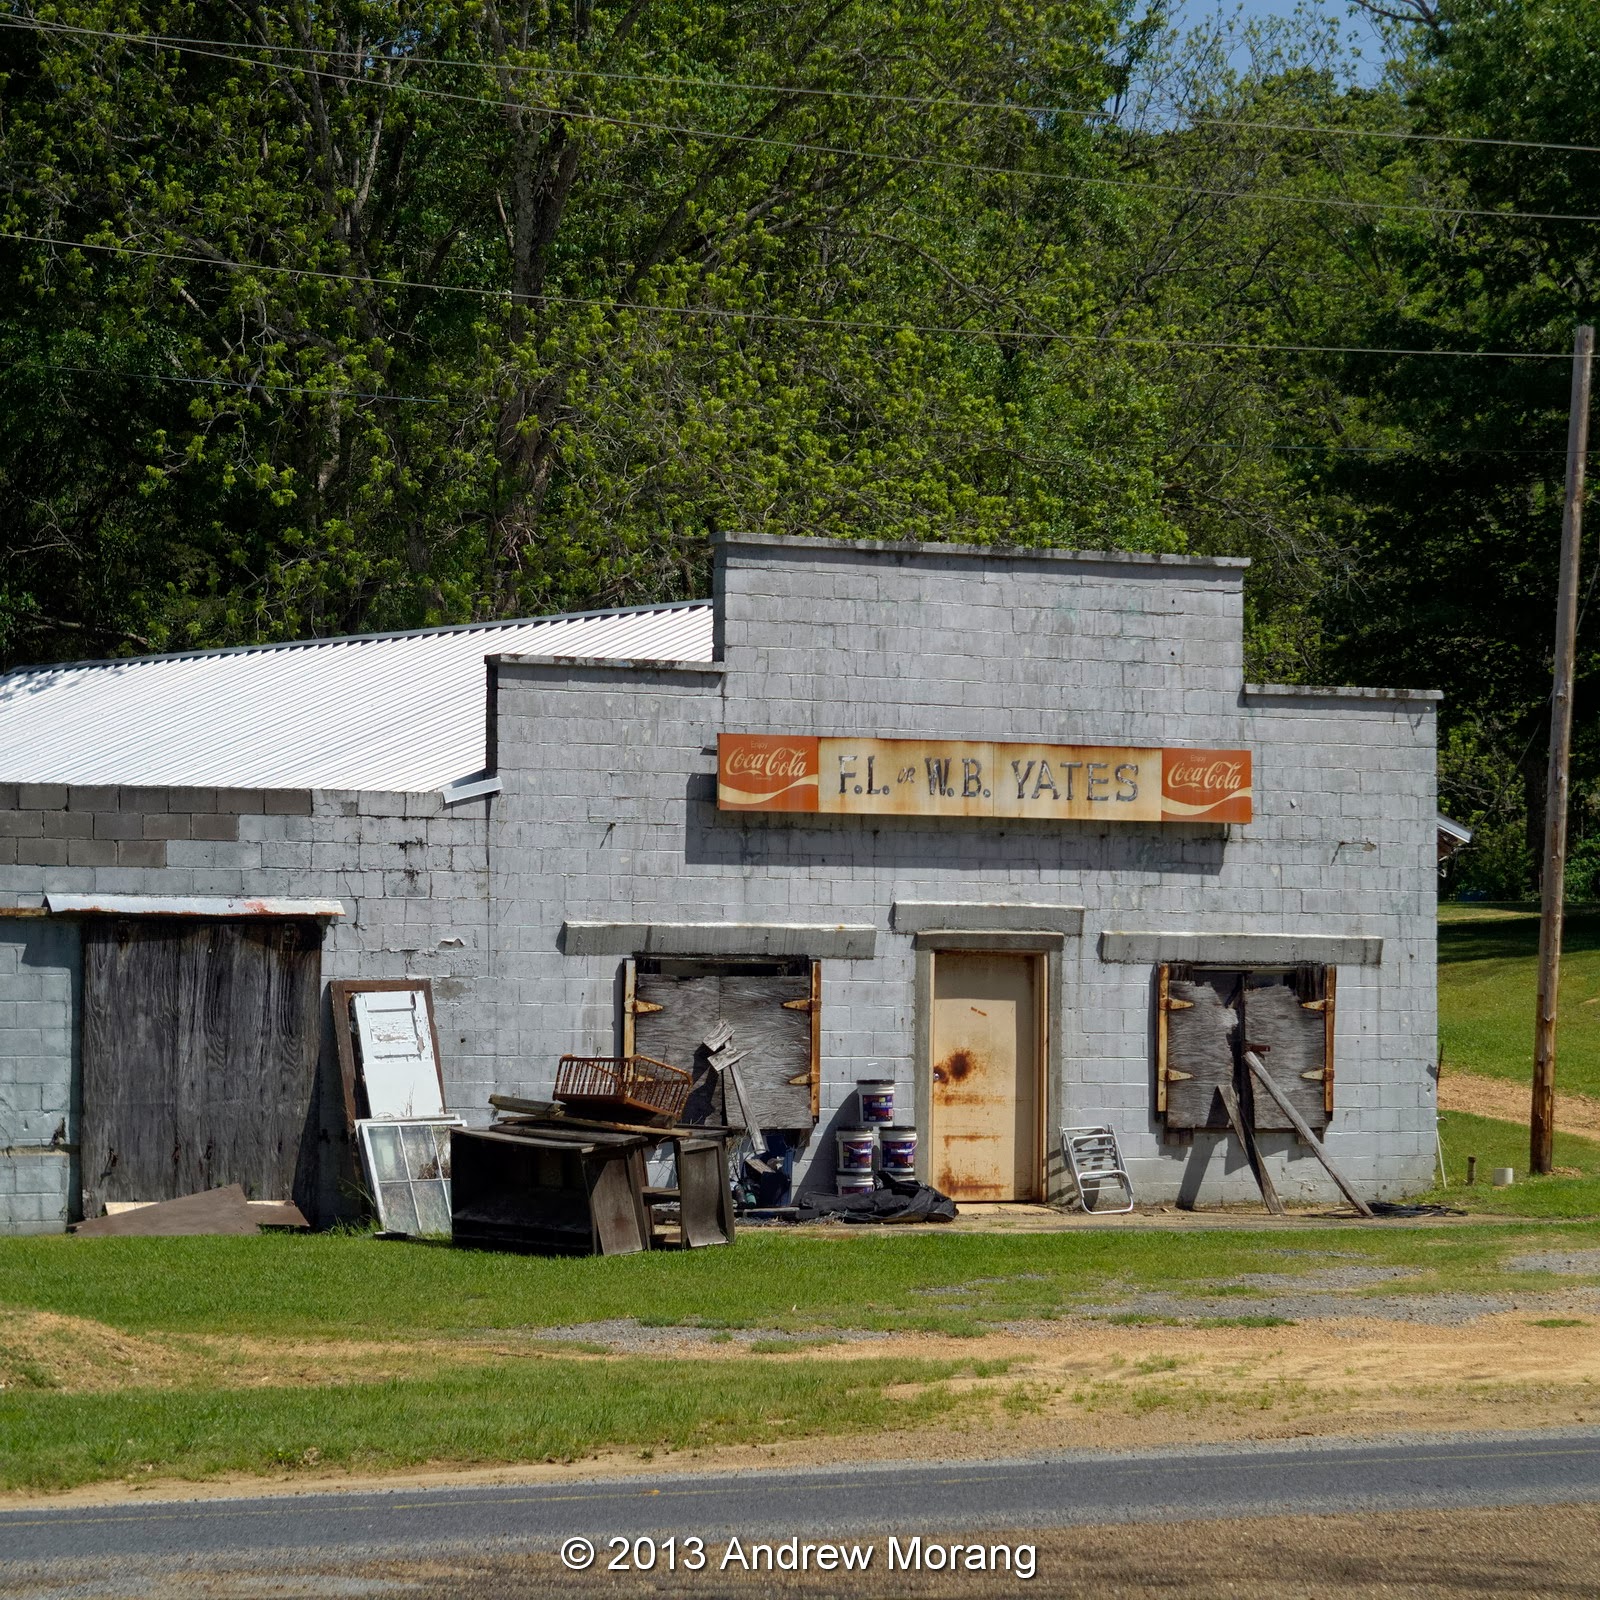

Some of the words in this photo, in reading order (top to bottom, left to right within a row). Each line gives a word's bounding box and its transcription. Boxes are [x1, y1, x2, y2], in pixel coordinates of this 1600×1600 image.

[751, 741, 768, 749] Enjoy
[1190, 755, 1206, 763] Enjoy
[725, 747, 808, 776] Coca-Cola
[1167, 761, 1244, 789] Coca-Cola
[838, 755, 890, 795] F.L.
[924, 757, 991, 797] W.B.
[1011, 760, 1139, 802] YATES
